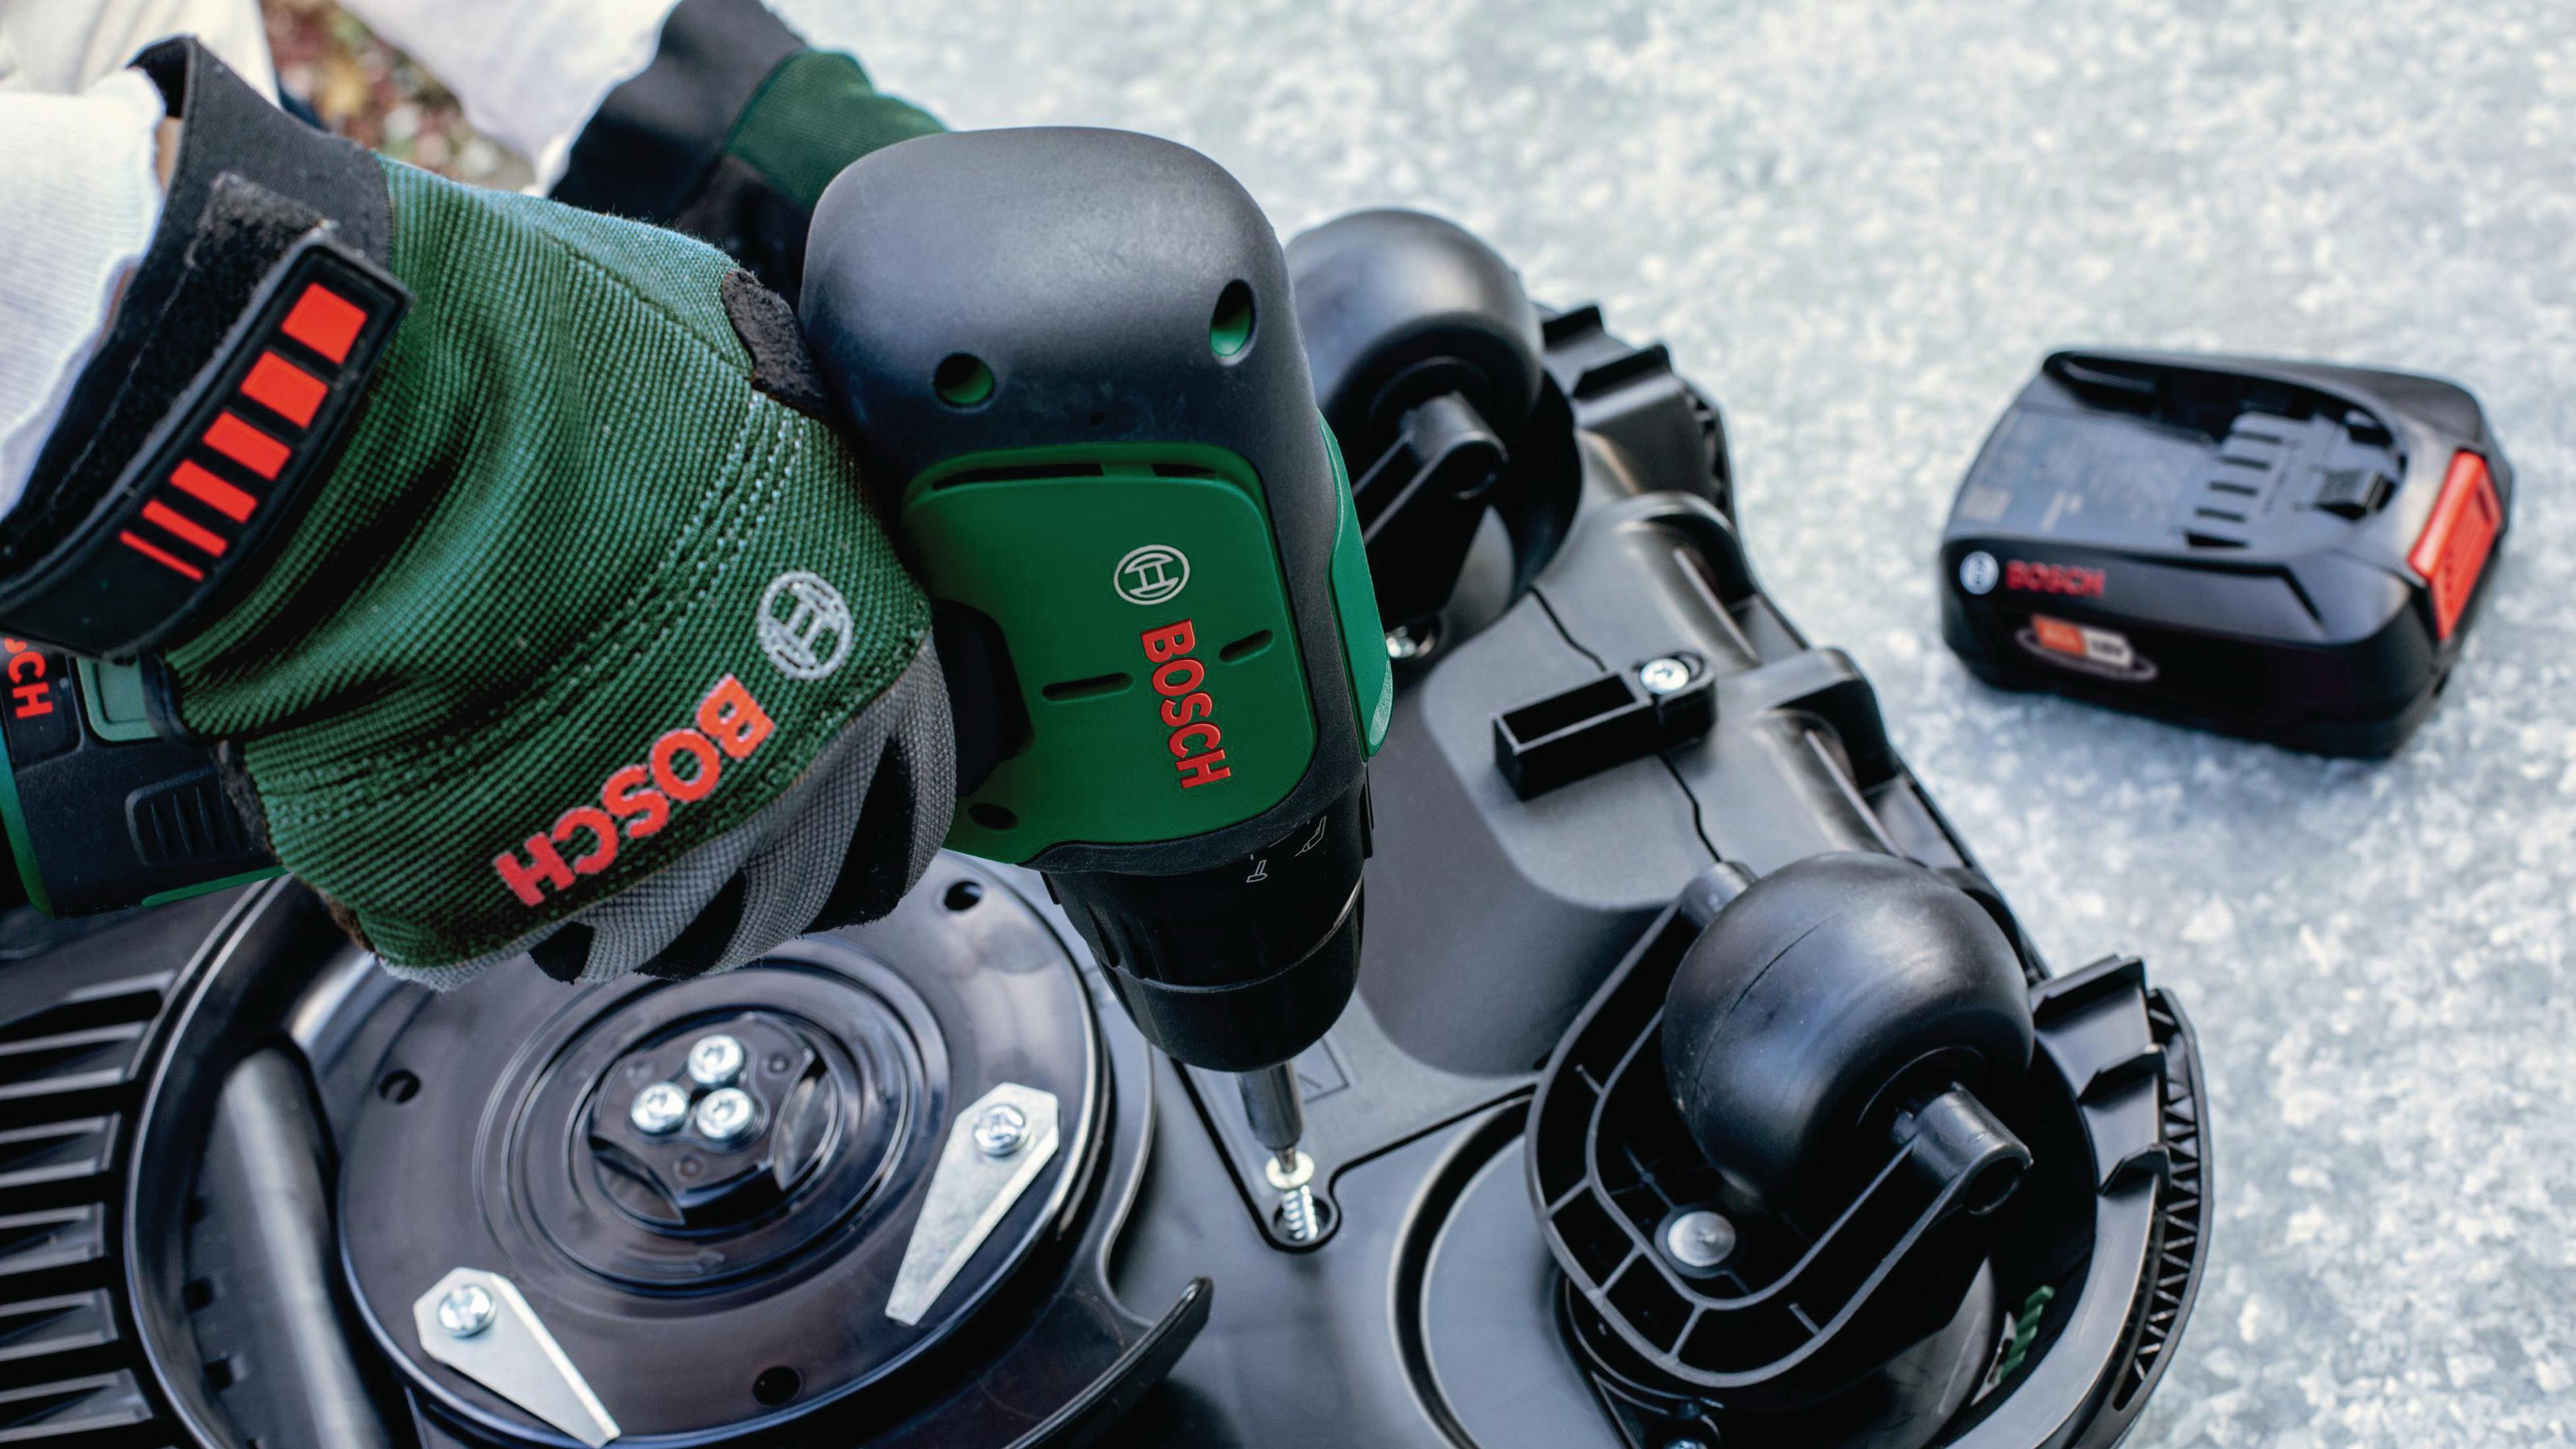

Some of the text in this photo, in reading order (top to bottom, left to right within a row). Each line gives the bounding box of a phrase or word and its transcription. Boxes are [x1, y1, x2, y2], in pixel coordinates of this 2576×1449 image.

[2006, 560, 2106, 596] BOSCH
[1140, 618, 1231, 789] BOSCH
[494, 673, 775, 906] BOSCH
